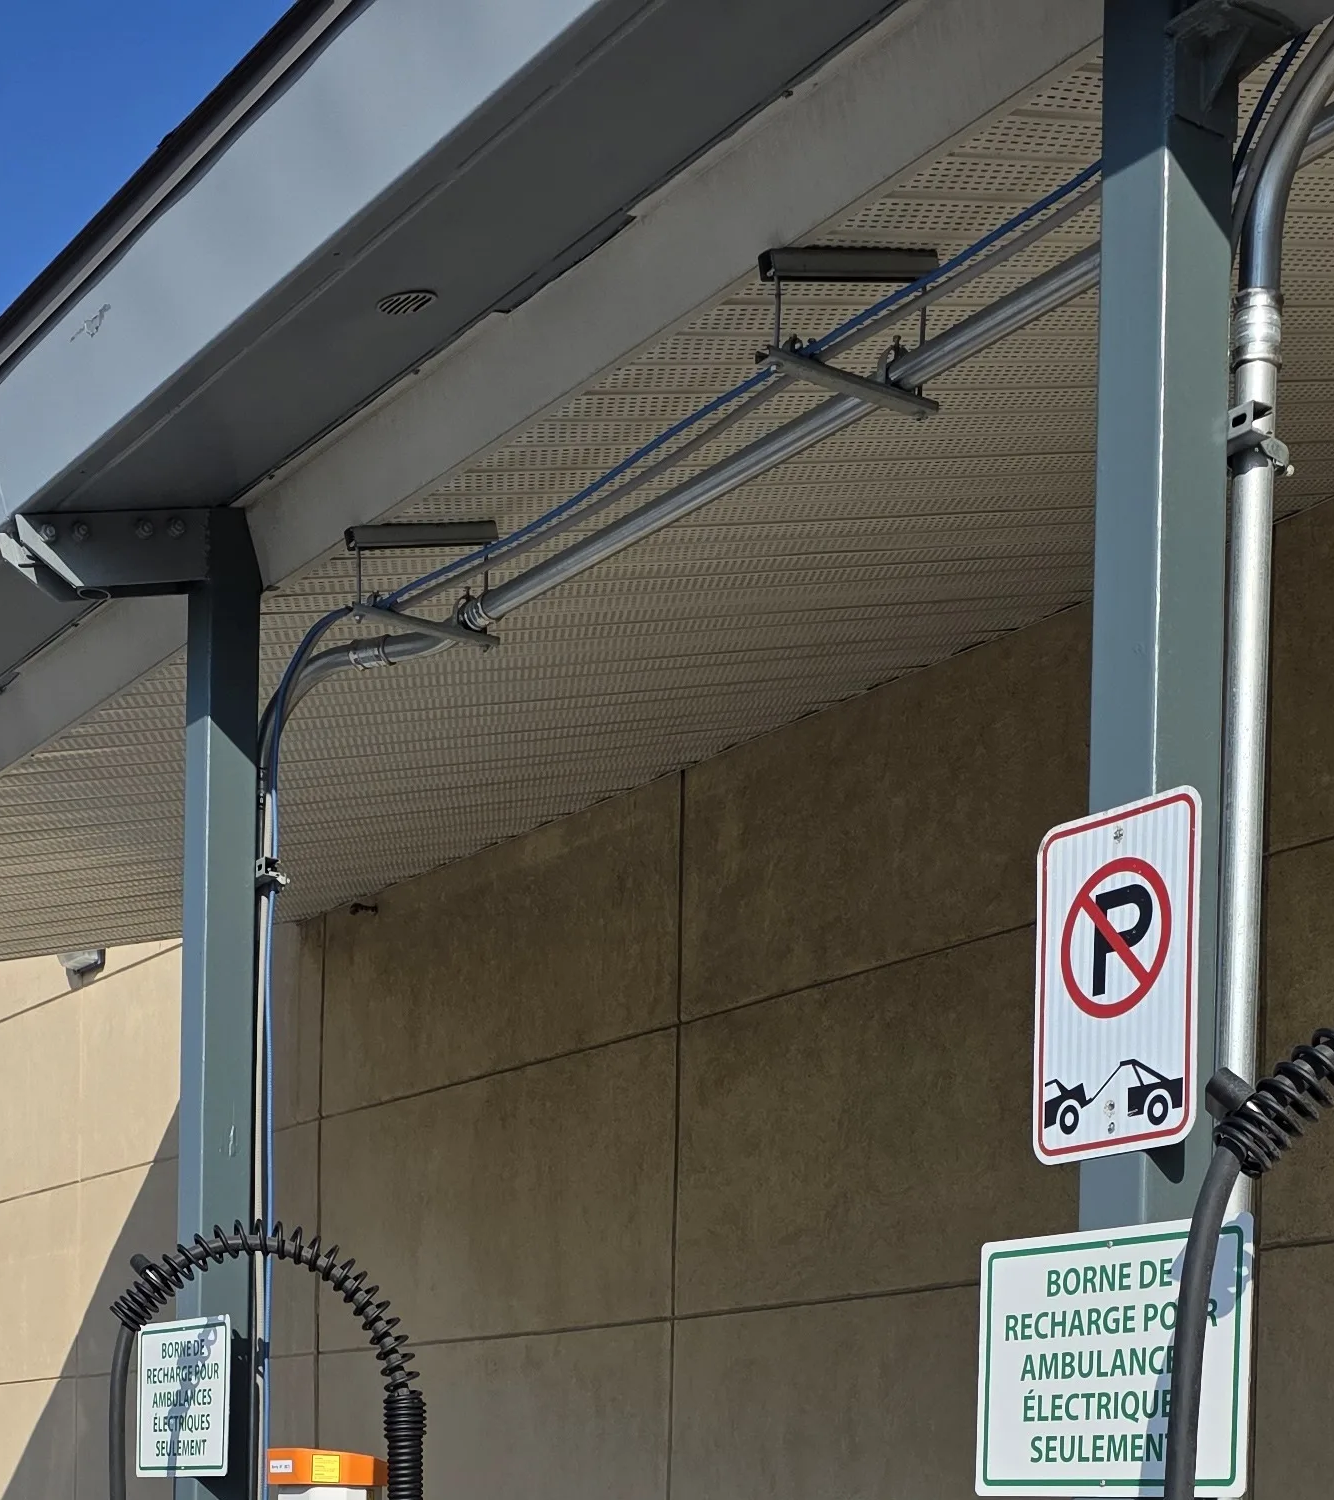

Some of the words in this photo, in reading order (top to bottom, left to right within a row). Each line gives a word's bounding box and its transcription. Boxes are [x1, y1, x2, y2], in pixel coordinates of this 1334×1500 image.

[1092, 883, 1153, 997] P
[1046, 1261, 1132, 1298] BORNE
[1139, 1258, 1173, 1289] DE
[1005, 1304, 1136, 1342] RECHARGE
[1143, 1298, 1218, 1332] POR
[161, 1340, 191, 1360] BORNE
[193, 1338, 205, 1357] DE
[147, 1364, 192, 1385] RECHARGE
[194, 1362, 220, 1381] POUR
[1020, 1345, 1175, 1382] AMBULANCE
[152, 1388, 212, 1409] AMBULANCES
[1023, 1389, 1173, 1423] ÉLECTRIQUE
[153, 1413, 211, 1433] ÉLECTRIQUES
[156, 1439, 207, 1457] SEULEMENT
